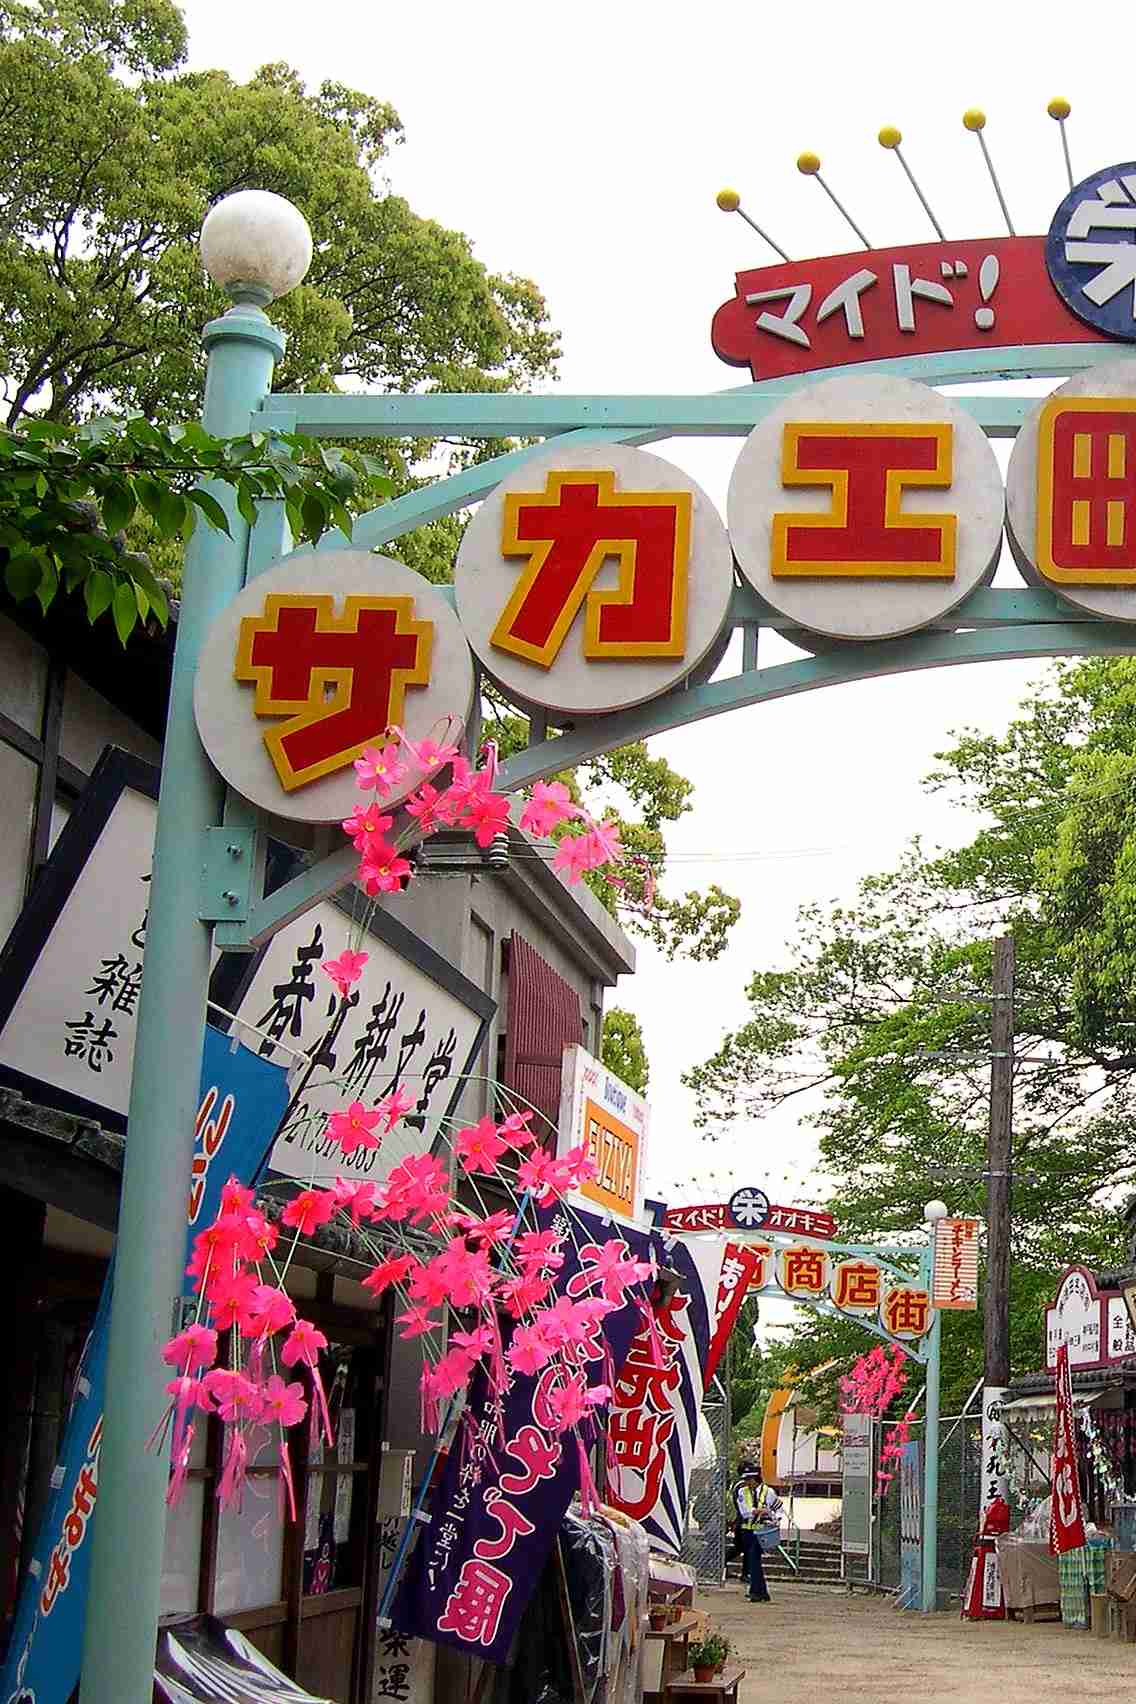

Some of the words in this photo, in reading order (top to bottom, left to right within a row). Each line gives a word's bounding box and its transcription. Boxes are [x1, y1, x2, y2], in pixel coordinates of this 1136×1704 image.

[743, 252, 1002, 350] マイド!
[667, 1207, 725, 1227] マイド!
[768, 1209, 833, 1234] オオキニ
